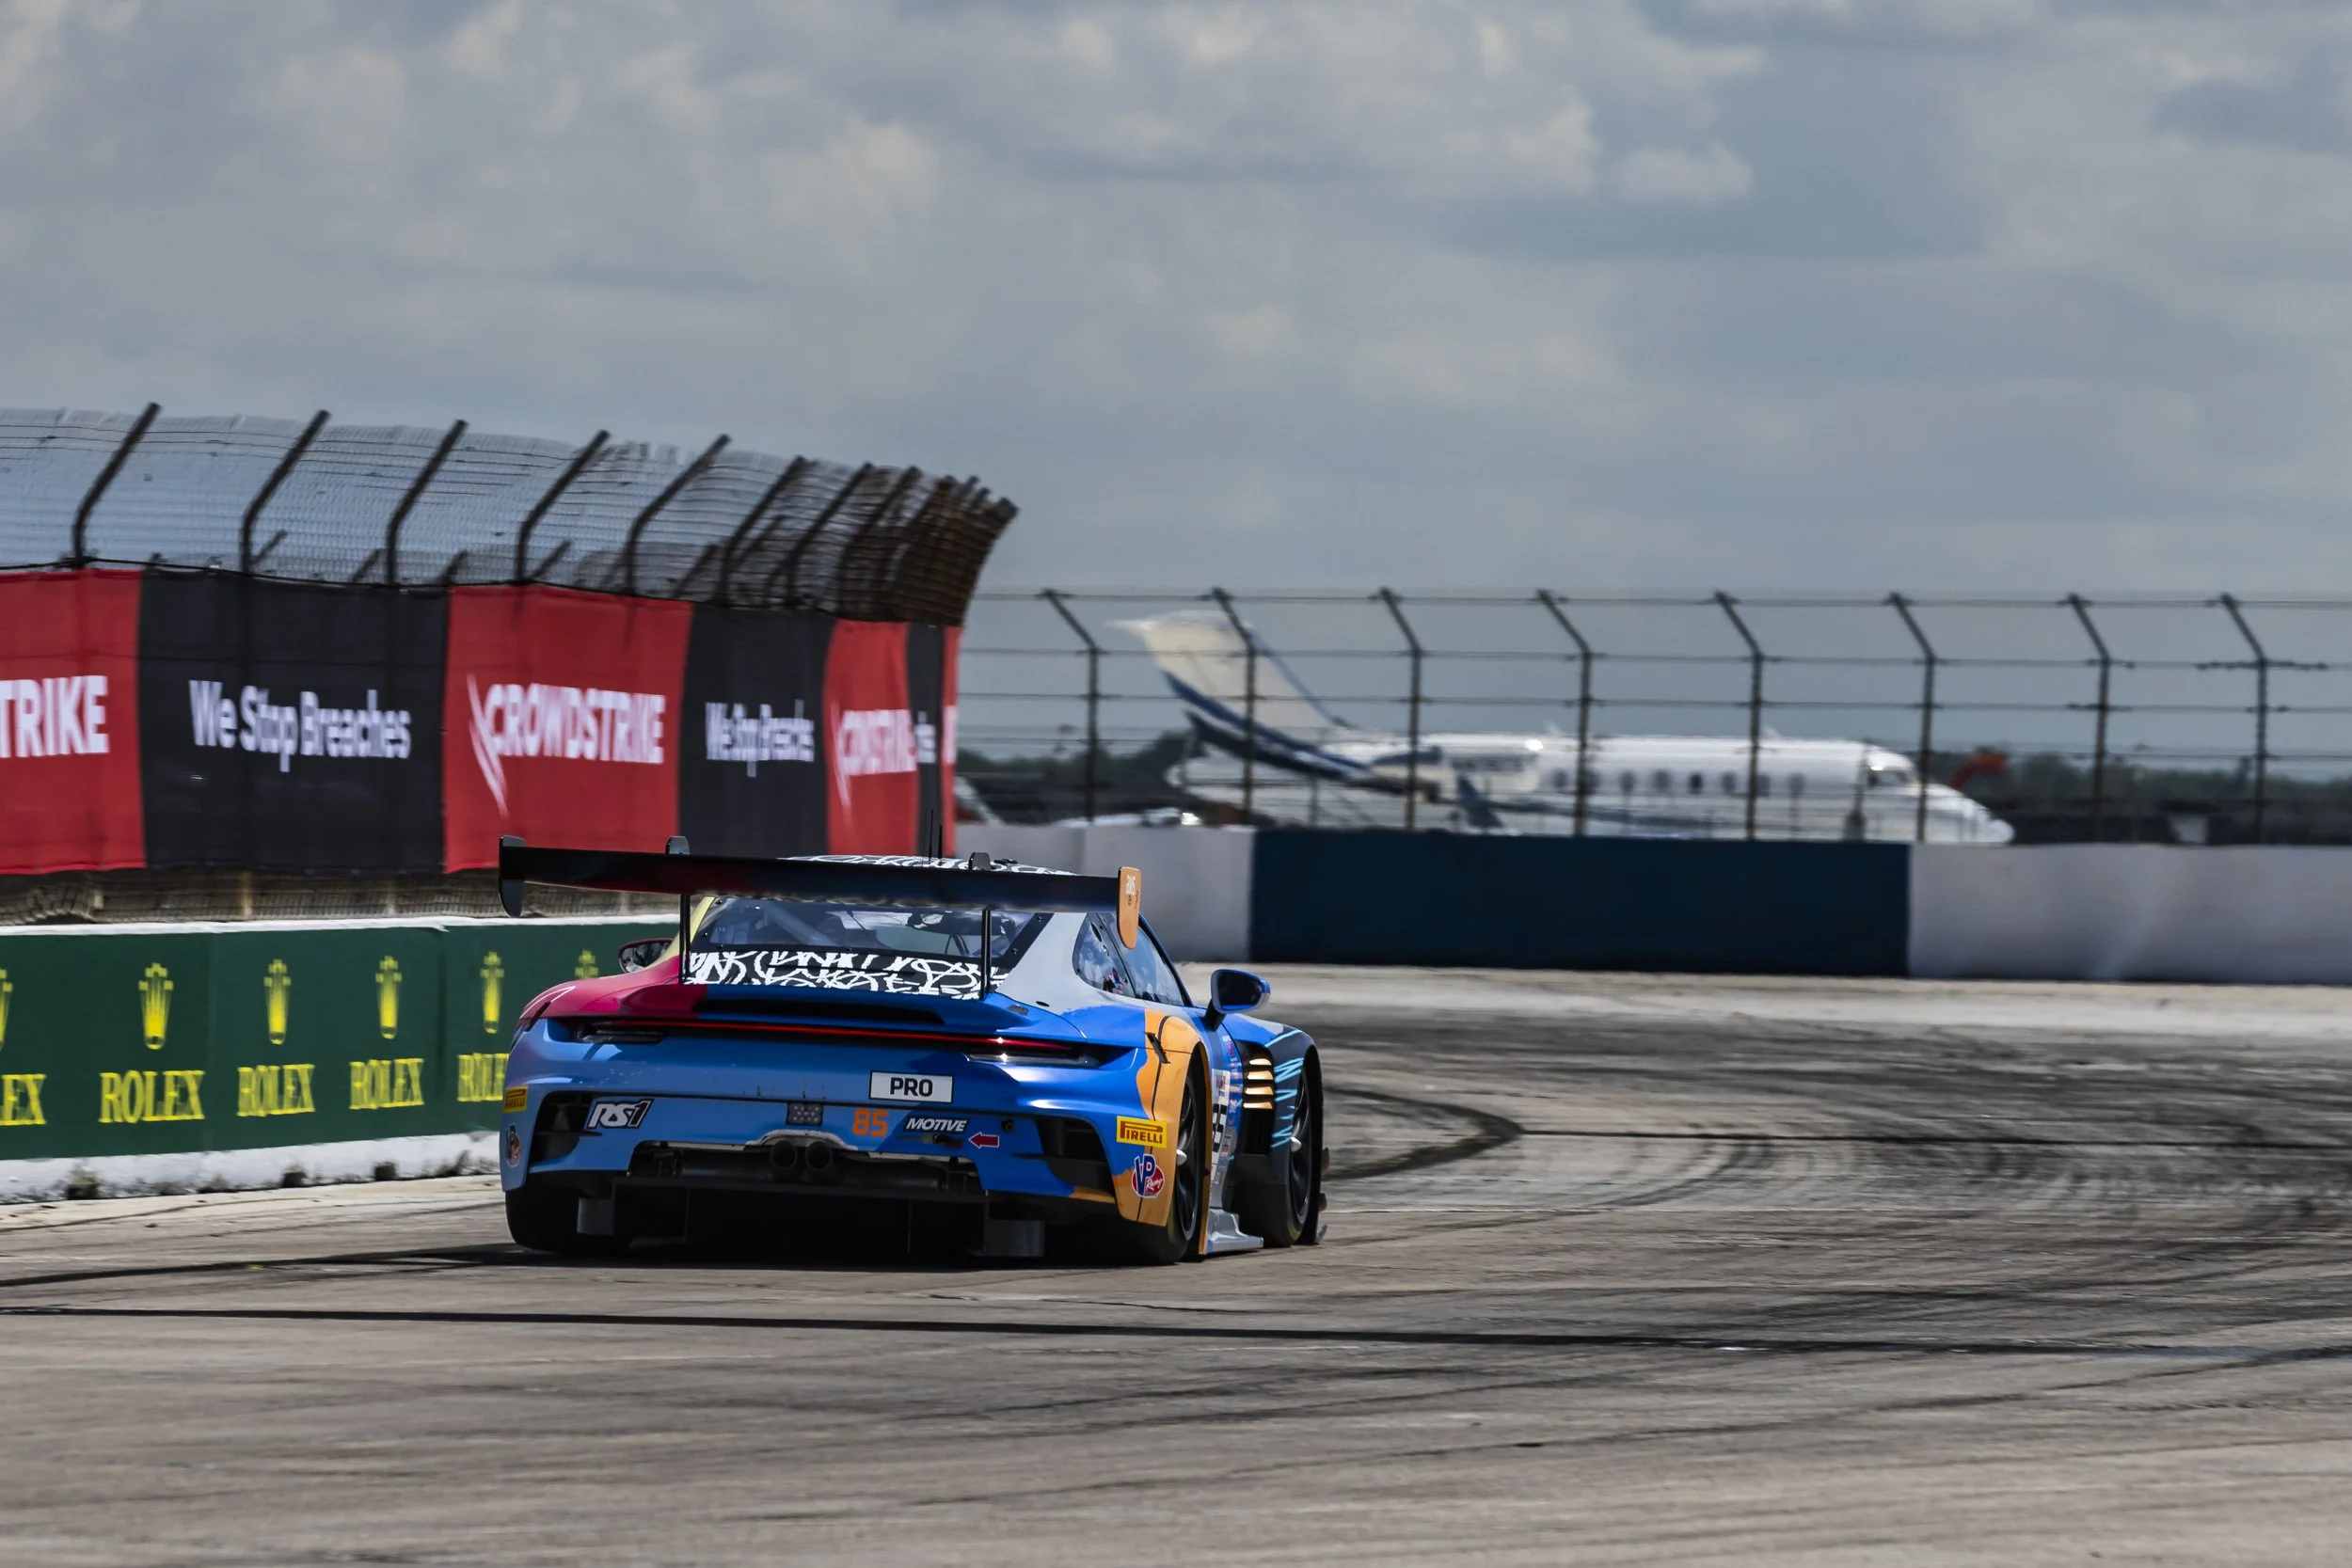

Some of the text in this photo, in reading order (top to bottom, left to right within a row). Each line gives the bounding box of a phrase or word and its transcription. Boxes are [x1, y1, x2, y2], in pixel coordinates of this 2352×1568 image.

[189, 680, 412, 772] We Stop Breaches
[485, 683, 665, 764] CROWDSTRIKE
[0, 1073, 46, 1126] EX
[98, 1069, 205, 1124] ROLEX
[237, 1064, 315, 1117] ROLEX
[349, 1059, 424, 1110] ROLEX
[457, 1053, 510, 1101] ROLE
[890, 1077, 933, 1098] PRO
[852, 1108, 889, 1137] 85
[905, 1117, 967, 1132] MOTIVE
[1120, 1120, 1164, 1145] PIRELLI
[1134, 1153, 1156, 1196] VP
